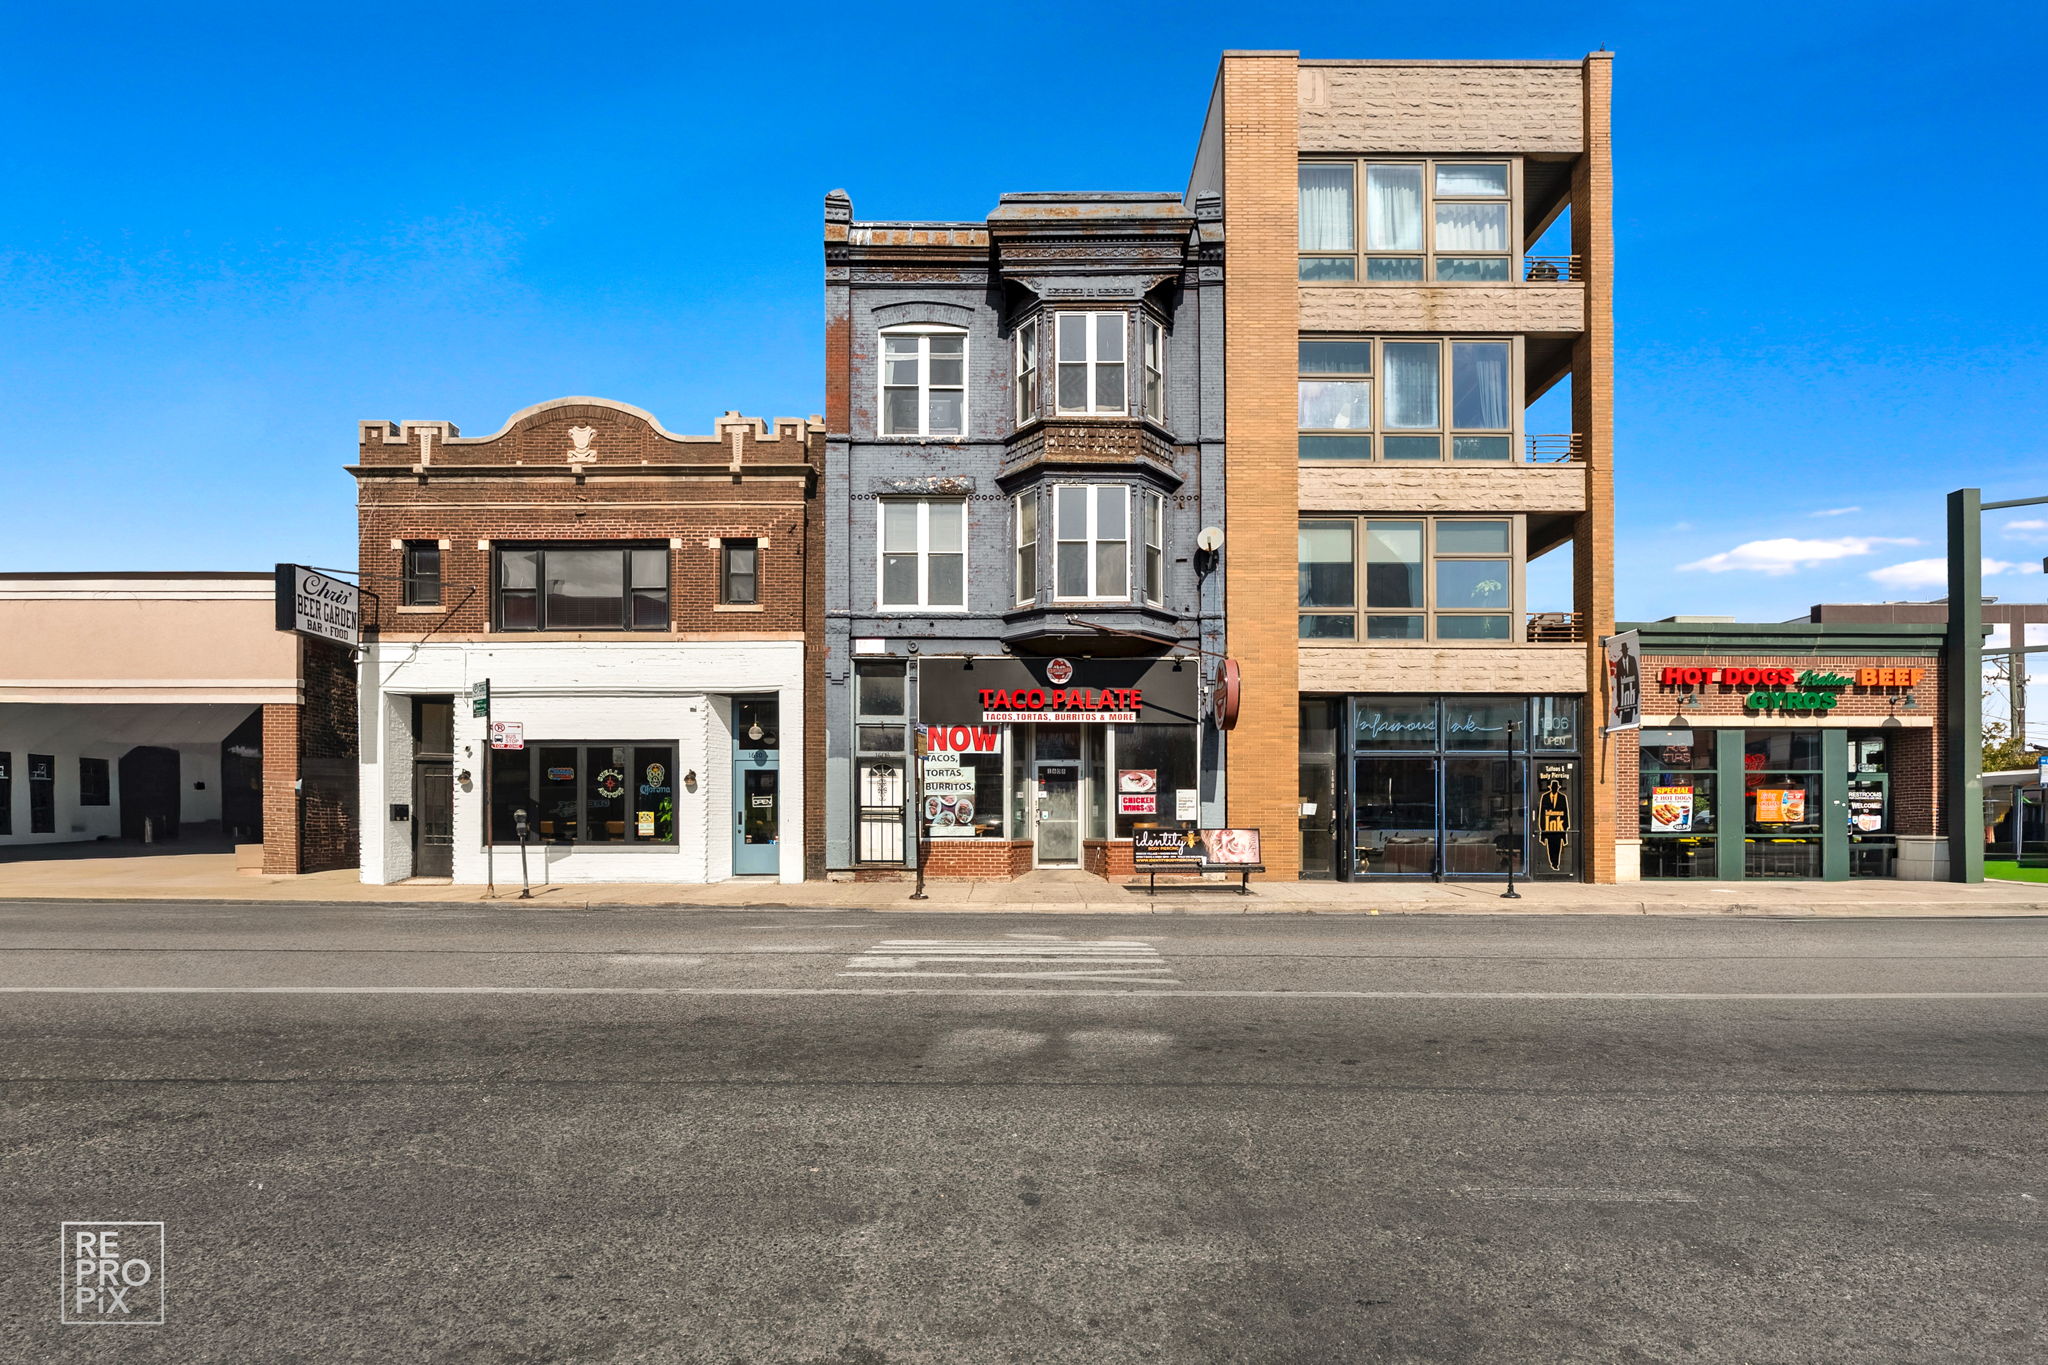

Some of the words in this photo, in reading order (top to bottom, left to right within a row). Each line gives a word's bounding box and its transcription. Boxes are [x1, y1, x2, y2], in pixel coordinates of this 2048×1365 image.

[302, 575, 352, 605] Chris'
[297, 593, 322, 620] BEER
[323, 602, 357, 631] GARDEN
[307, 619, 323, 633] BAR
[329, 626, 349, 640] FOOD
[1662, 667, 1718, 685] HOT
[1721, 667, 1795, 685] DOGS
[1798, 670, 1856, 686] Italian
[1856, 668, 1925, 686] BEEF
[978, 688, 1046, 709] TACO
[1052, 688, 1143, 709] PALATE
[1748, 691, 1838, 709] GYROS
[1054, 713, 1097, 721] BURRITOS
[1099, 713, 1105, 721] &
[1108, 713, 1134, 721] MORE
[1354, 711, 1437, 738] Infamous
[1447, 713, 1503, 733] Ink
[928, 725, 999, 751] NOW
[1544, 736, 1565, 745] OPEN
[926, 754, 958, 763] TACOS,
[926, 769, 964, 778] TORTAS,
[640, 784, 671, 795] Corona
[925, 782, 974, 792] BURRITOS,
[1545, 815, 1564, 831] Ink
[1135, 831, 1186, 855] identity
